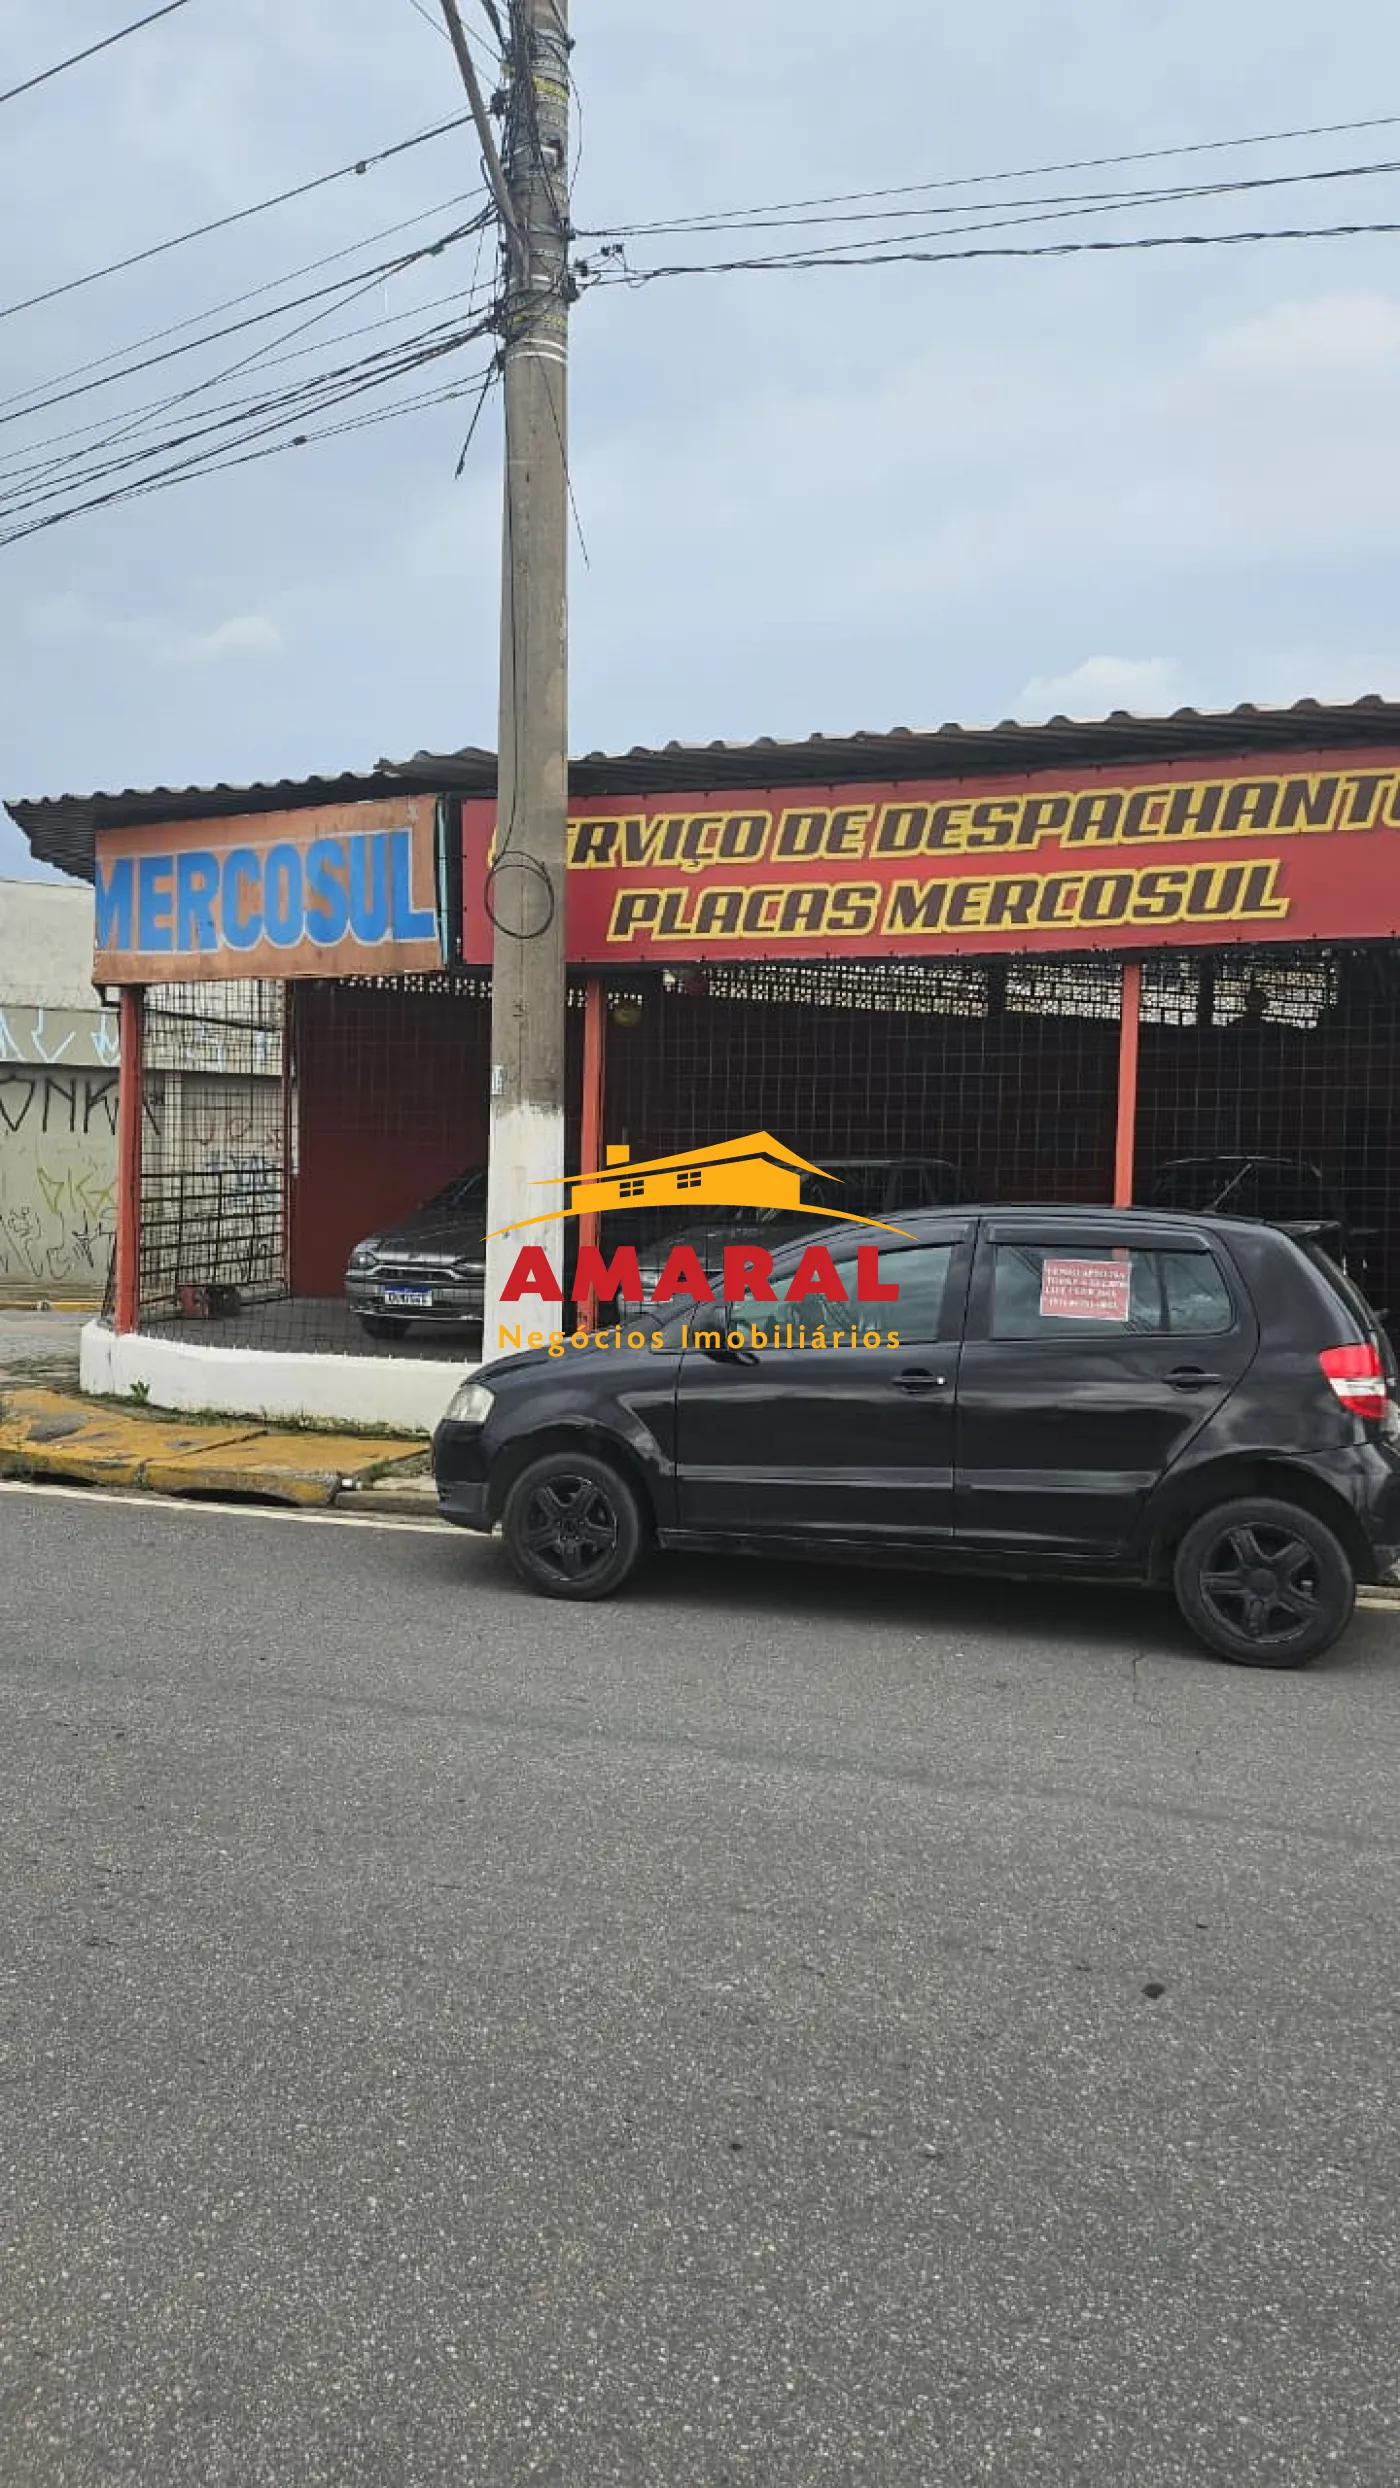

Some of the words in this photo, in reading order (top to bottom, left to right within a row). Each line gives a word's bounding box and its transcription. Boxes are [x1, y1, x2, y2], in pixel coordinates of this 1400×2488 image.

[487, 814, 772, 873] RVIÇO
[771, 805, 874, 862] DE
[869, 769, 1400, 858] DESPACHANT
[95, 829, 437, 954] MERCOSUL
[607, 881, 880, 941] PLACAS
[883, 859, 1289, 934] MERCOSUL
